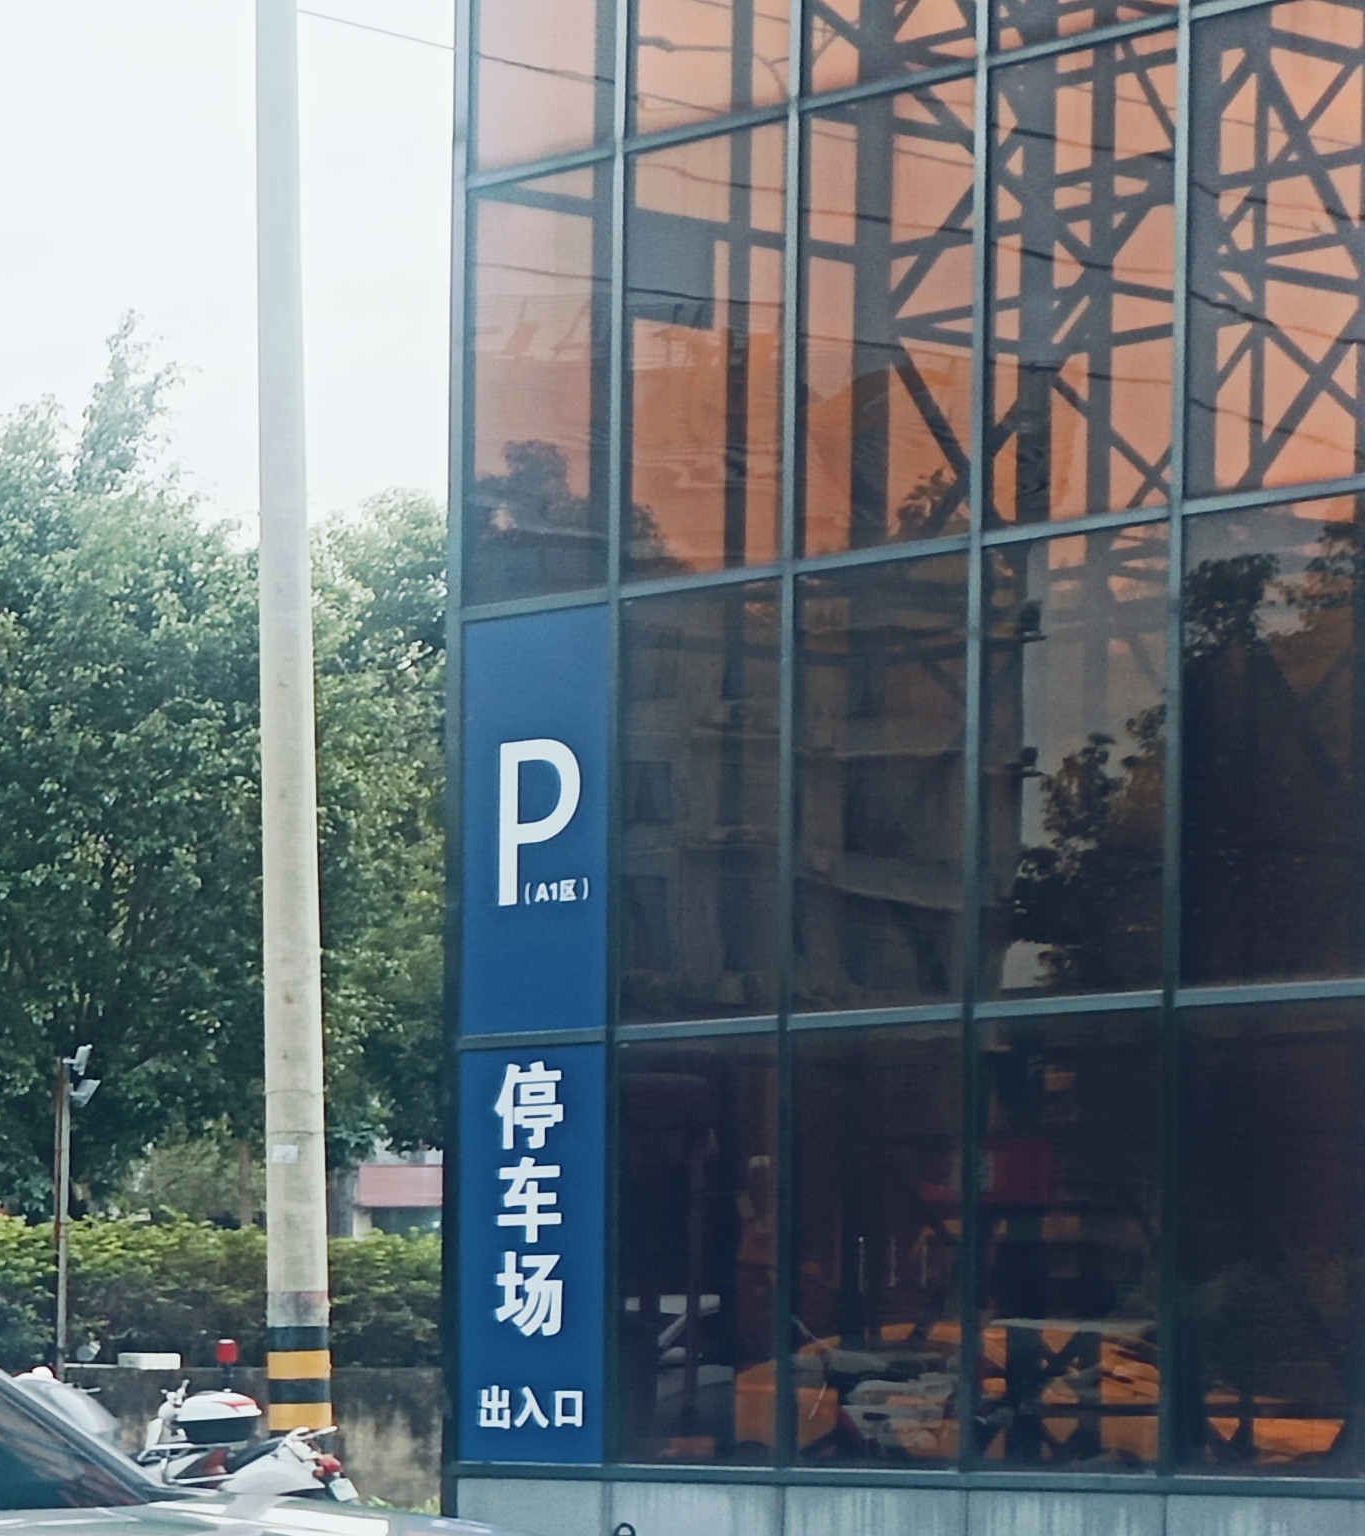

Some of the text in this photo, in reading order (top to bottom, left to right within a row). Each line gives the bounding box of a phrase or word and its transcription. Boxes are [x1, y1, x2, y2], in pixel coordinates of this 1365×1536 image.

[498, 738, 581, 906] P
[494, 1061, 564, 1337] 停车场
[478, 1385, 585, 1430] 出入口
